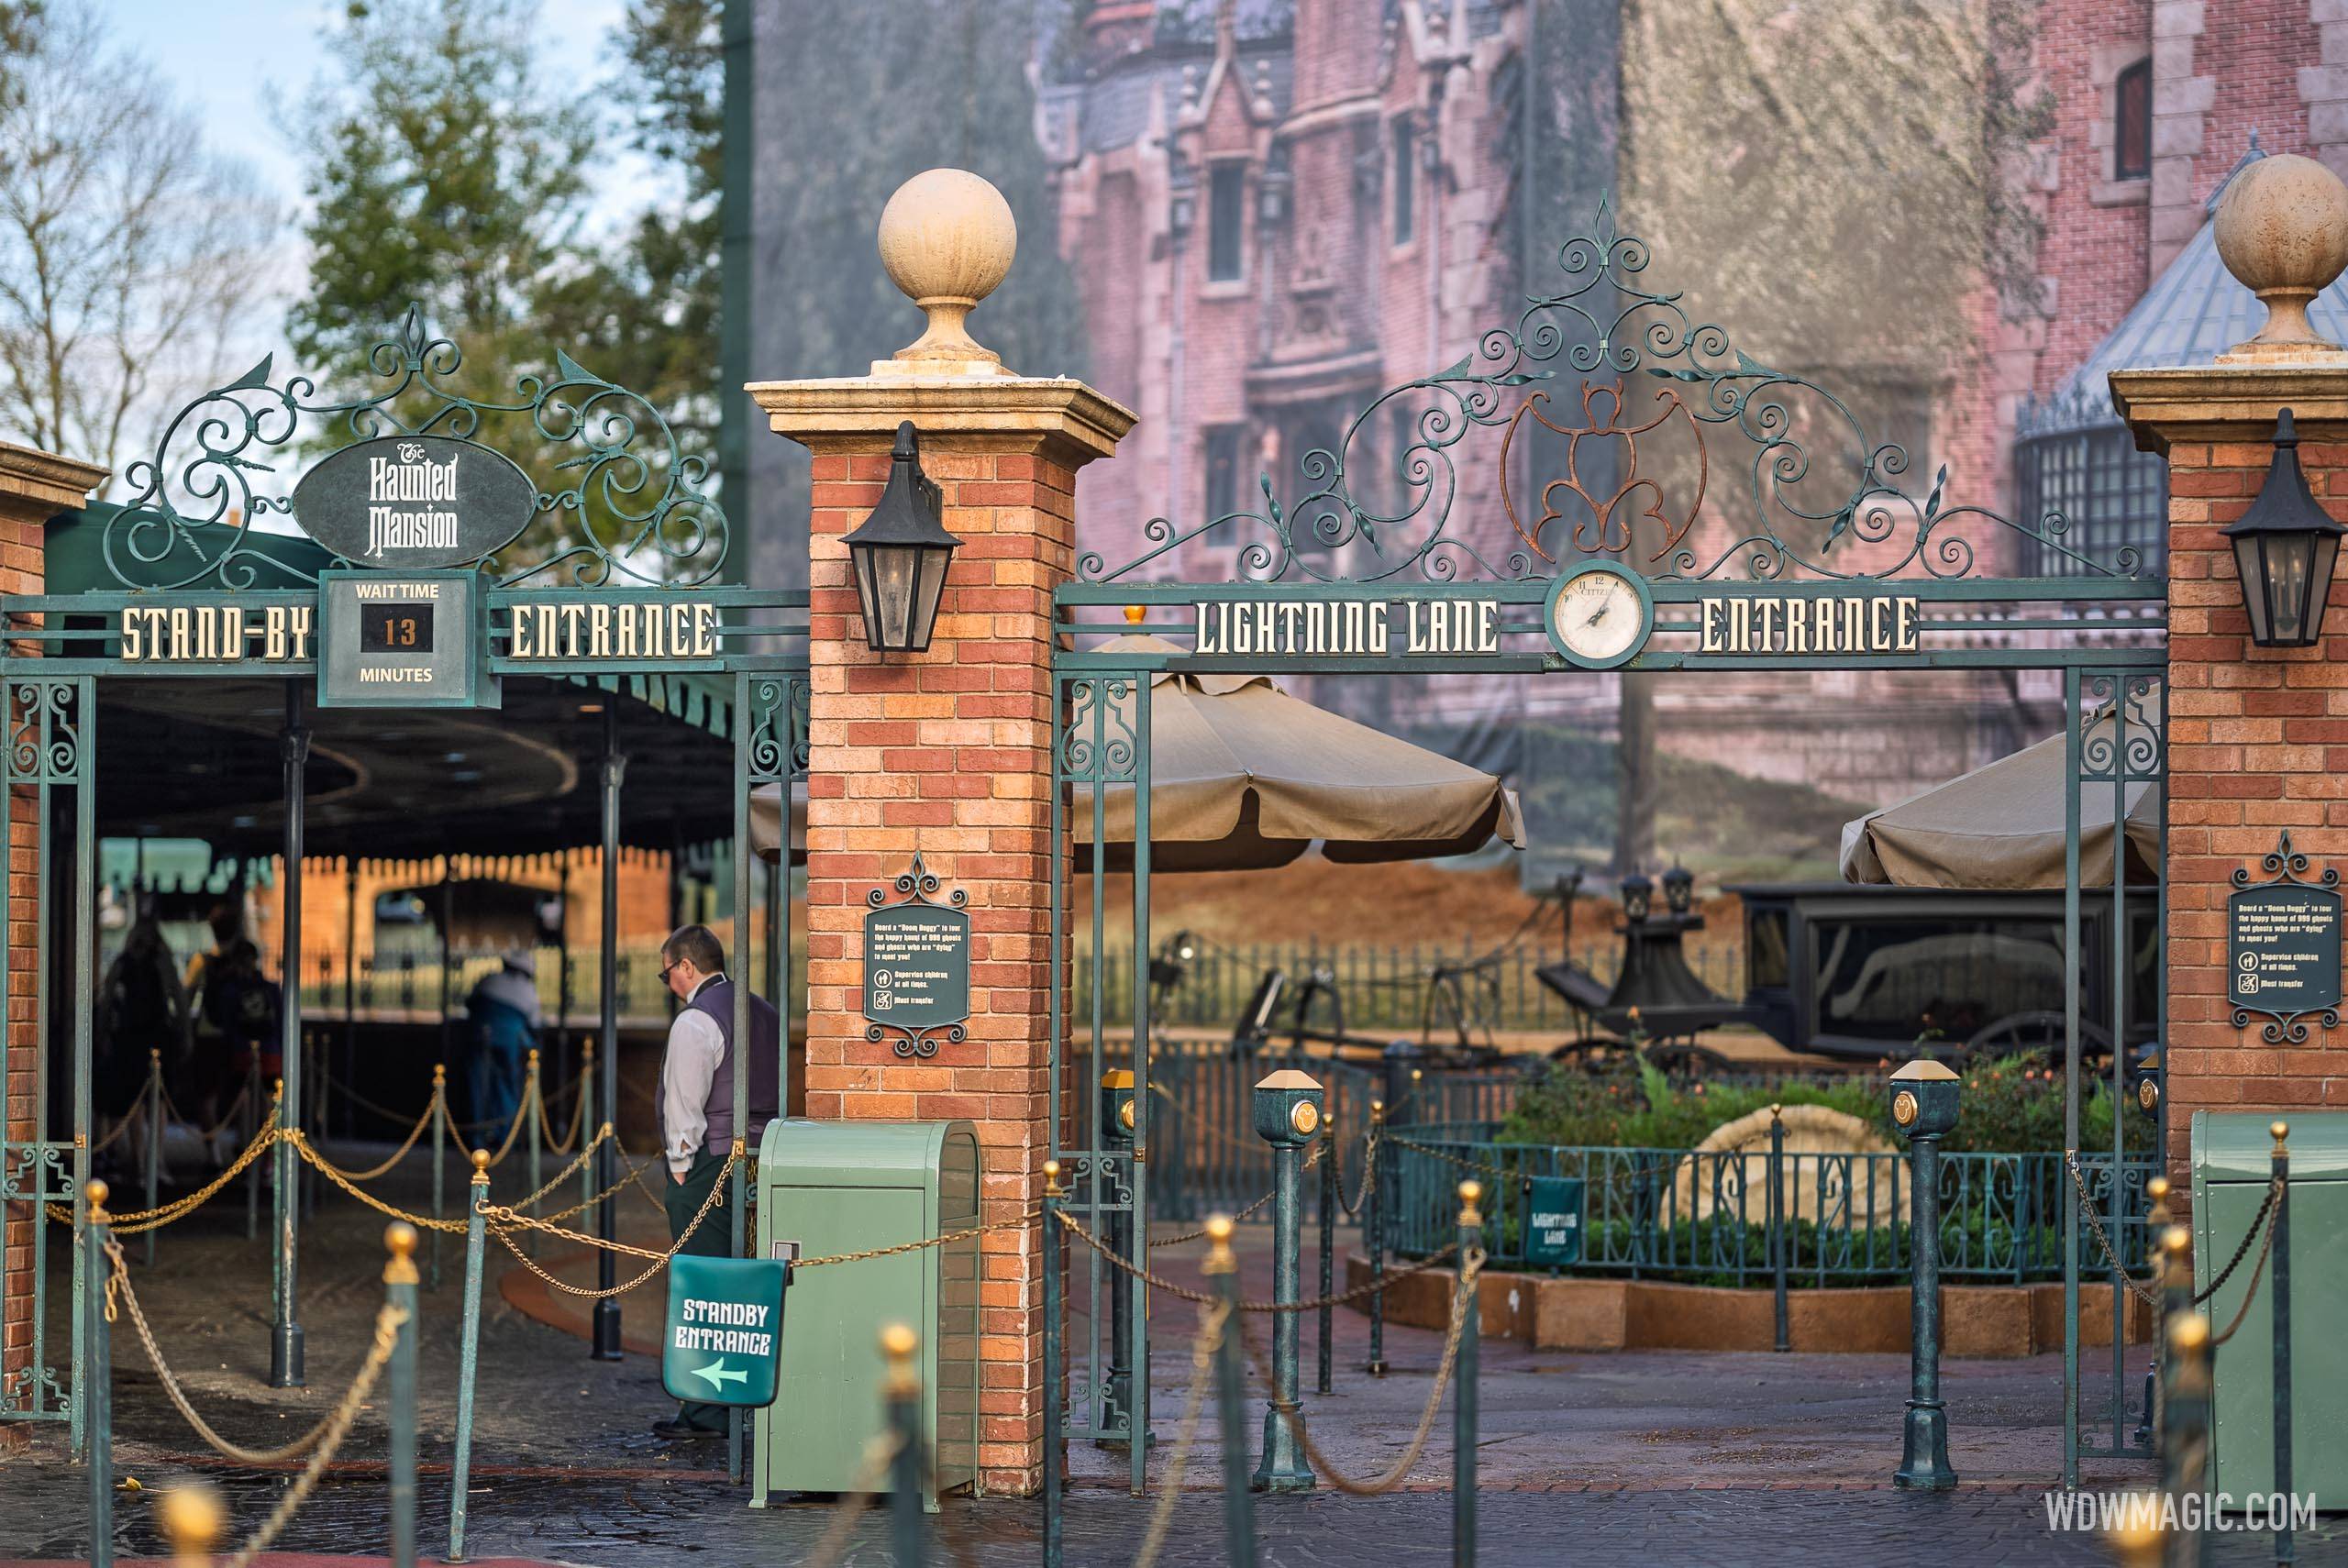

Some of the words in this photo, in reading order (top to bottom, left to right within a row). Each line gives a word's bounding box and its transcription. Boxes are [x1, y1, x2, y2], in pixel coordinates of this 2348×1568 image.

[397, 443, 426, 464] The
[369, 452, 459, 502] Haunted
[363, 503, 459, 559] Mansion
[355, 584, 398, 599] WAIT
[399, 584, 439, 599] TIME
[1578, 580, 1586, 590] 11
[1595, 576, 1604, 585] 12
[123, 606, 312, 660] STAND-BY
[511, 603, 714, 657] ENTRANCE
[384, 618, 416, 646] 13
[1195, 602, 1388, 654] LIGHTNING
[1406, 601, 1498, 653] LANE
[1701, 597, 1917, 653] ENTRANCE
[360, 668, 433, 682] MINUTES
[682, 1298, 770, 1328] STANDBY
[674, 1326, 772, 1357] ENTRANCE
